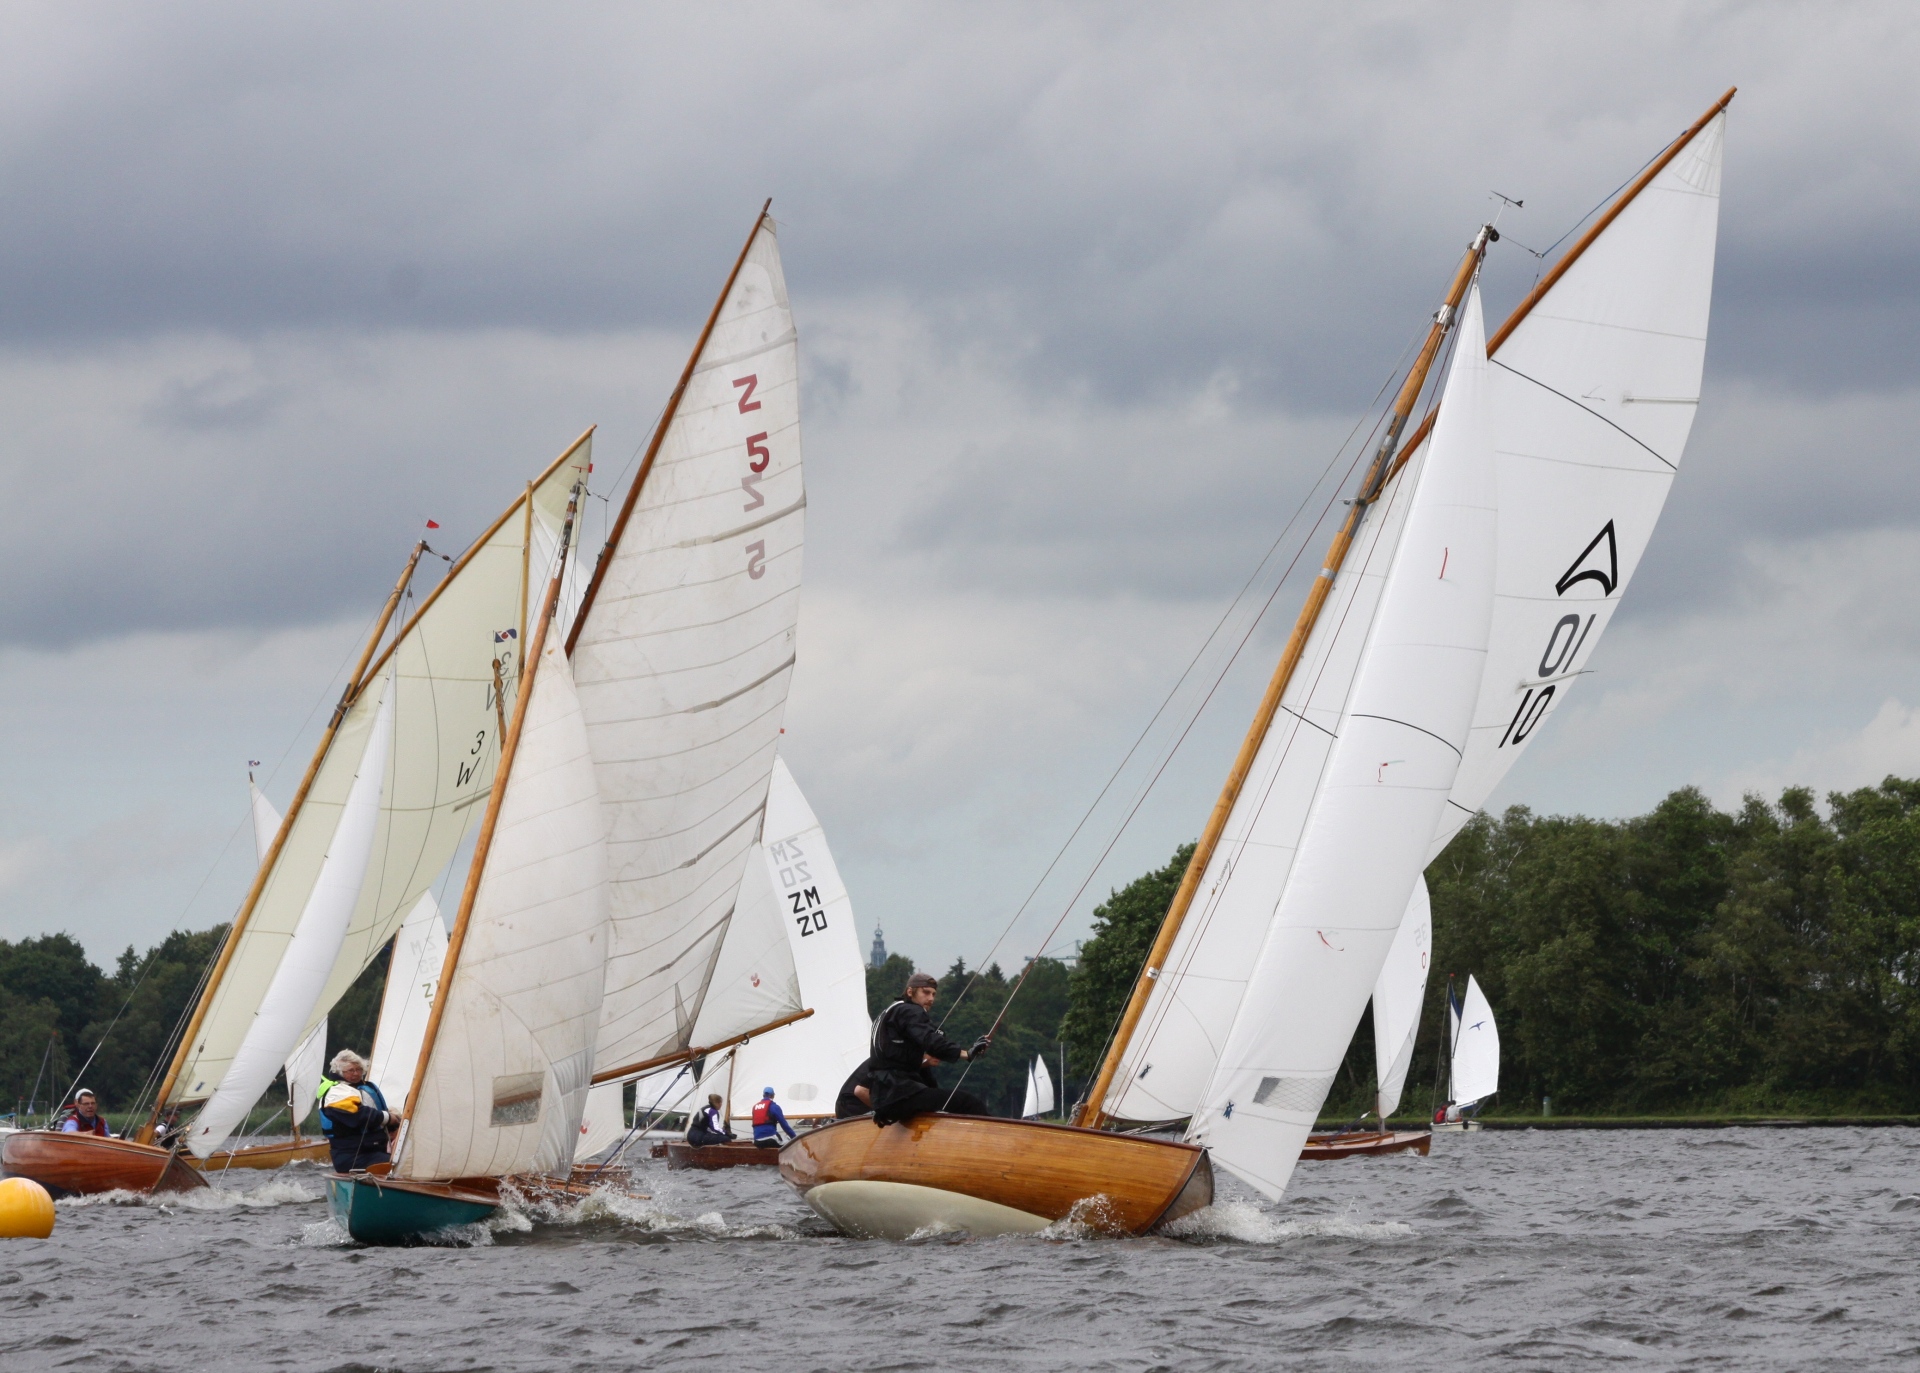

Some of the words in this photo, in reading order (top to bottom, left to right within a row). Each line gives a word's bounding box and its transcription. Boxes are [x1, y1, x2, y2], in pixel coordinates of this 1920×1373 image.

[746, 431, 770, 473] 5
[1498, 684, 1556, 749] 10
[471, 730, 485, 755] 3
[456, 757, 481, 788] W
[787, 886, 821, 914] ZM
